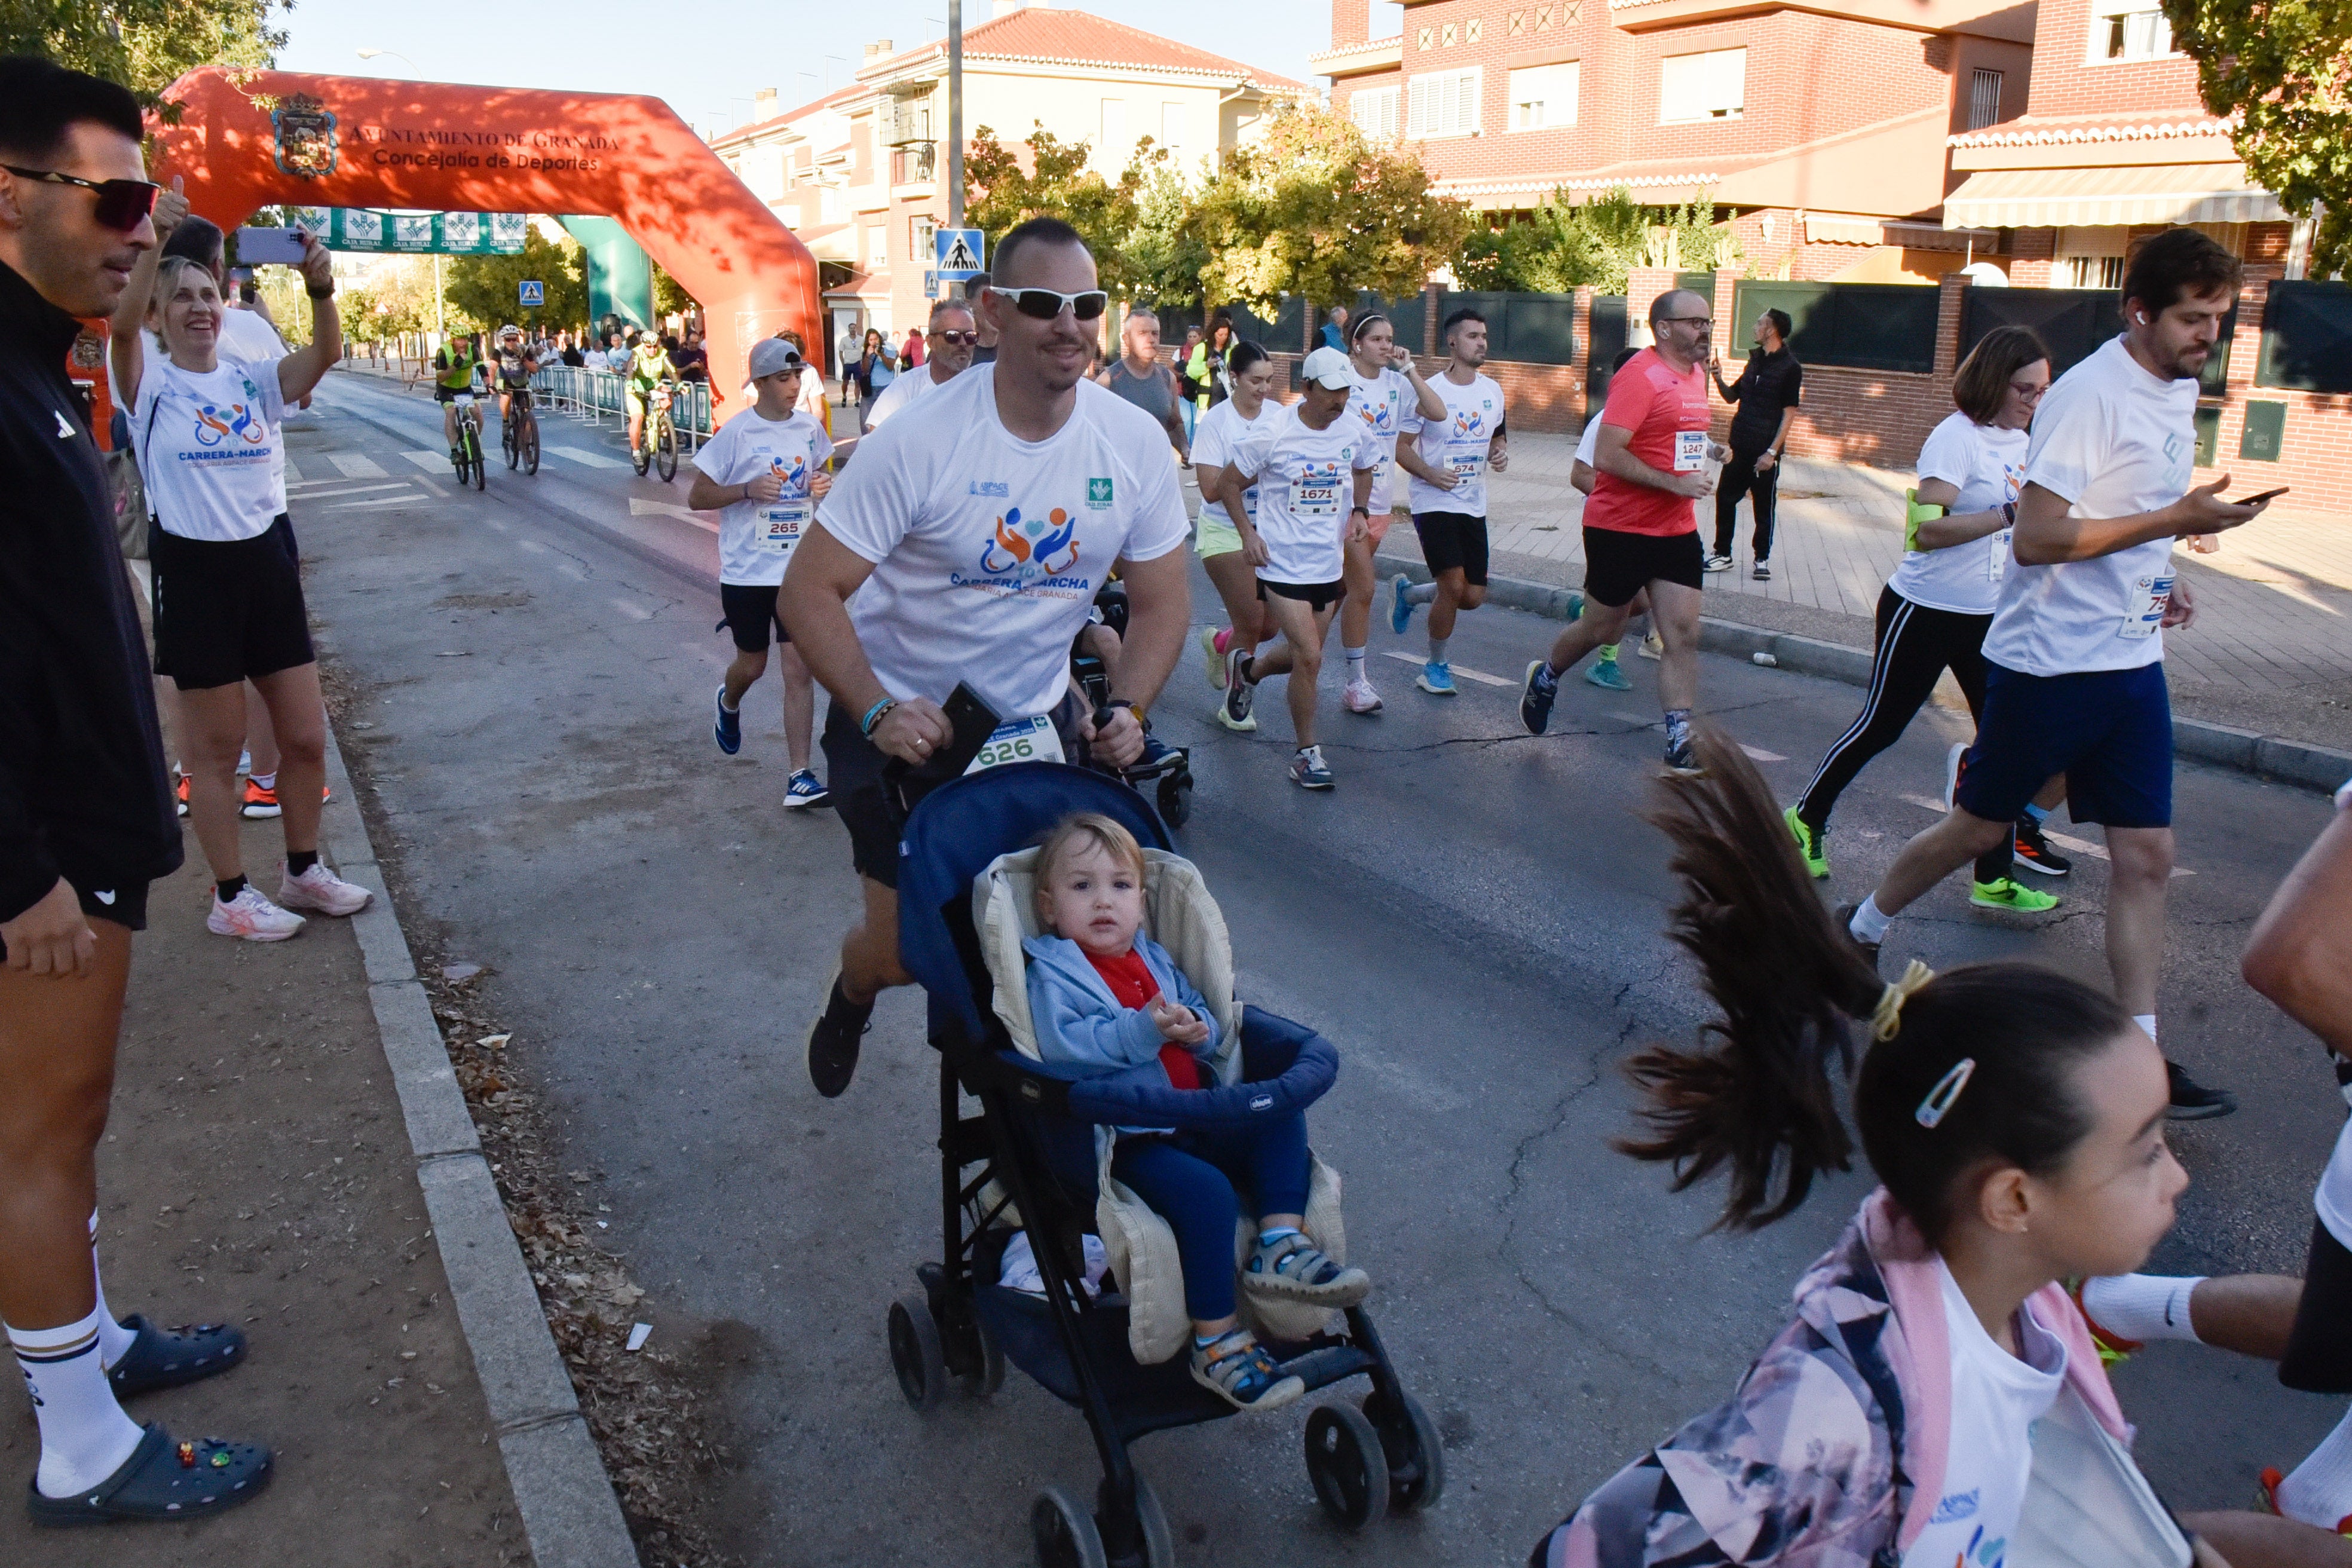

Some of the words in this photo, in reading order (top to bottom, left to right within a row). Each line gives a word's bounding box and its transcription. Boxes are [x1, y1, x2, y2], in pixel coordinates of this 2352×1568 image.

[349, 126, 498, 146] AYUNTAMIENTO
[505, 133, 526, 147] DE
[533, 133, 620, 150] GRANADA
[373, 149, 479, 170] Concejalía
[486, 153, 510, 168] de
[517, 154, 597, 172] Deportes
[179, 448, 271, 461] CARRERA-MARCH
[1683, 445, 1703, 454] 1247
[1454, 464, 1474, 473] 674
[1300, 489, 1333, 498] 1671
[770, 523, 798, 533] 265
[1037, 591, 1078, 600] GRANADA
[978, 739, 1033, 765] 626
